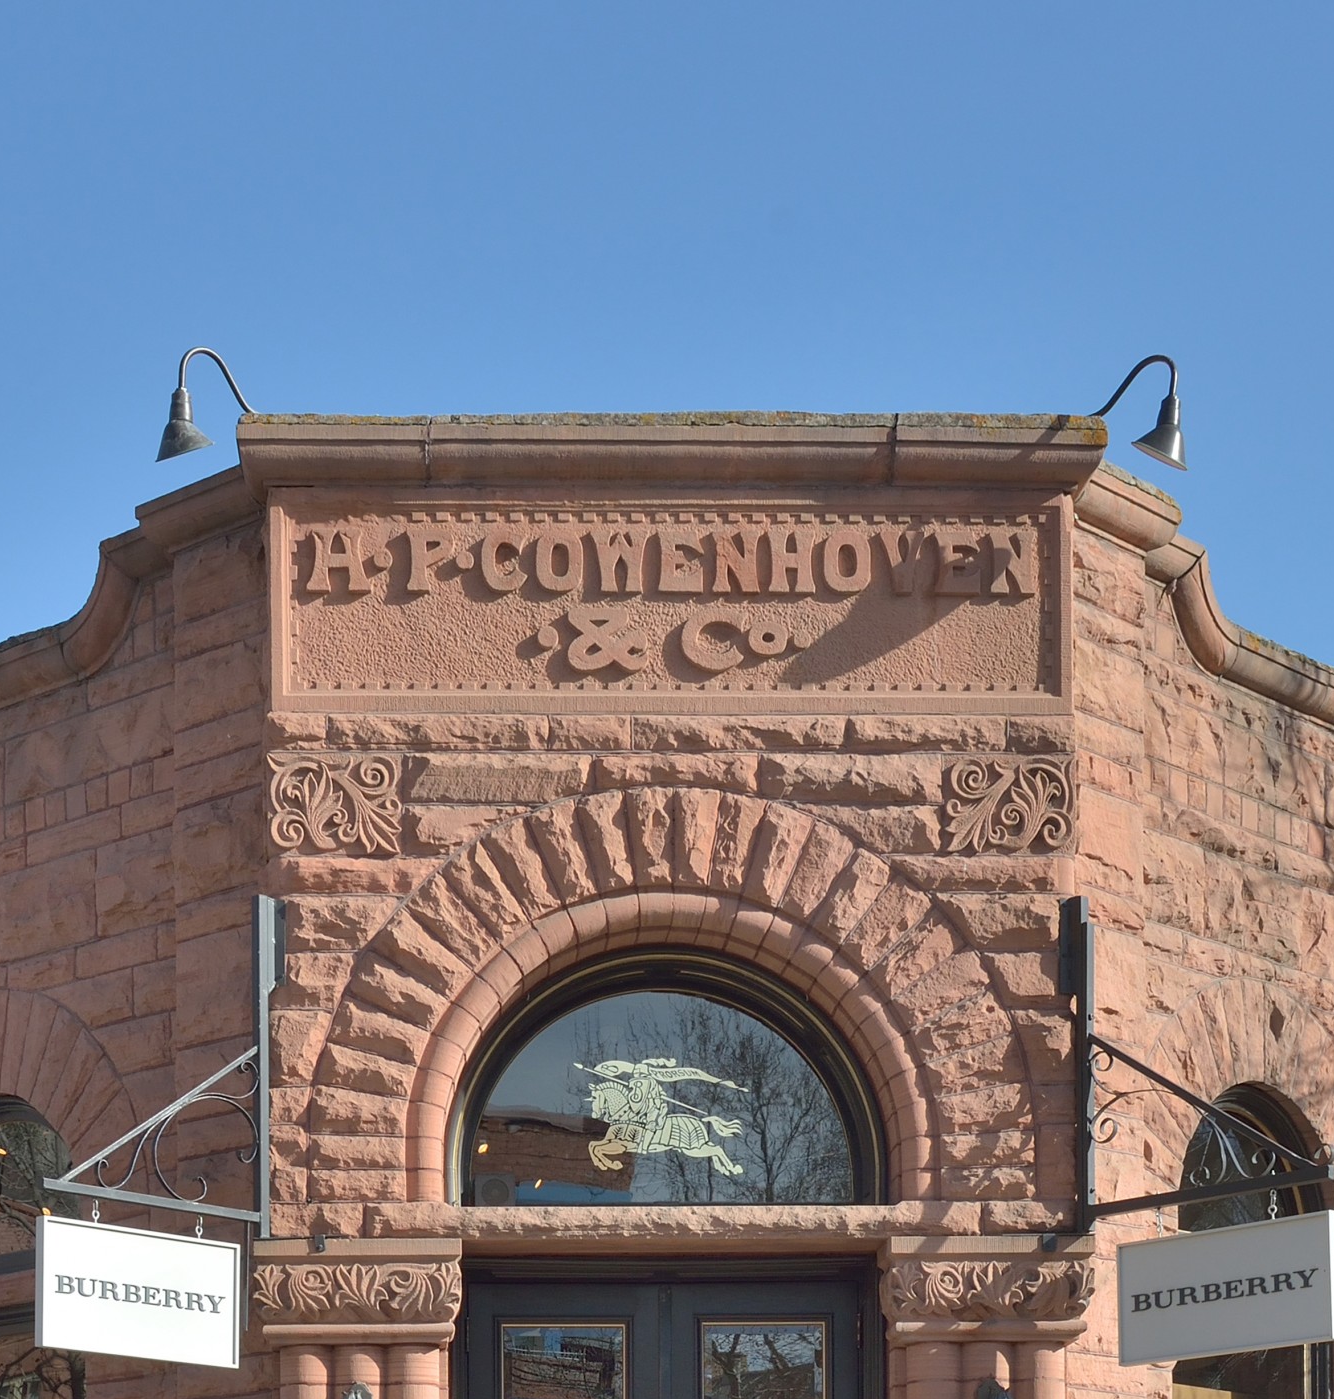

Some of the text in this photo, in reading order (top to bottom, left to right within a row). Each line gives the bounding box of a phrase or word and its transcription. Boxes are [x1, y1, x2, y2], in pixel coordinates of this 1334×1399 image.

[652, 1069, 701, 1080] PRORSUM
[55, 1274, 226, 1314] BURBERRY
[1131, 1267, 1319, 1313] BURBERRY
